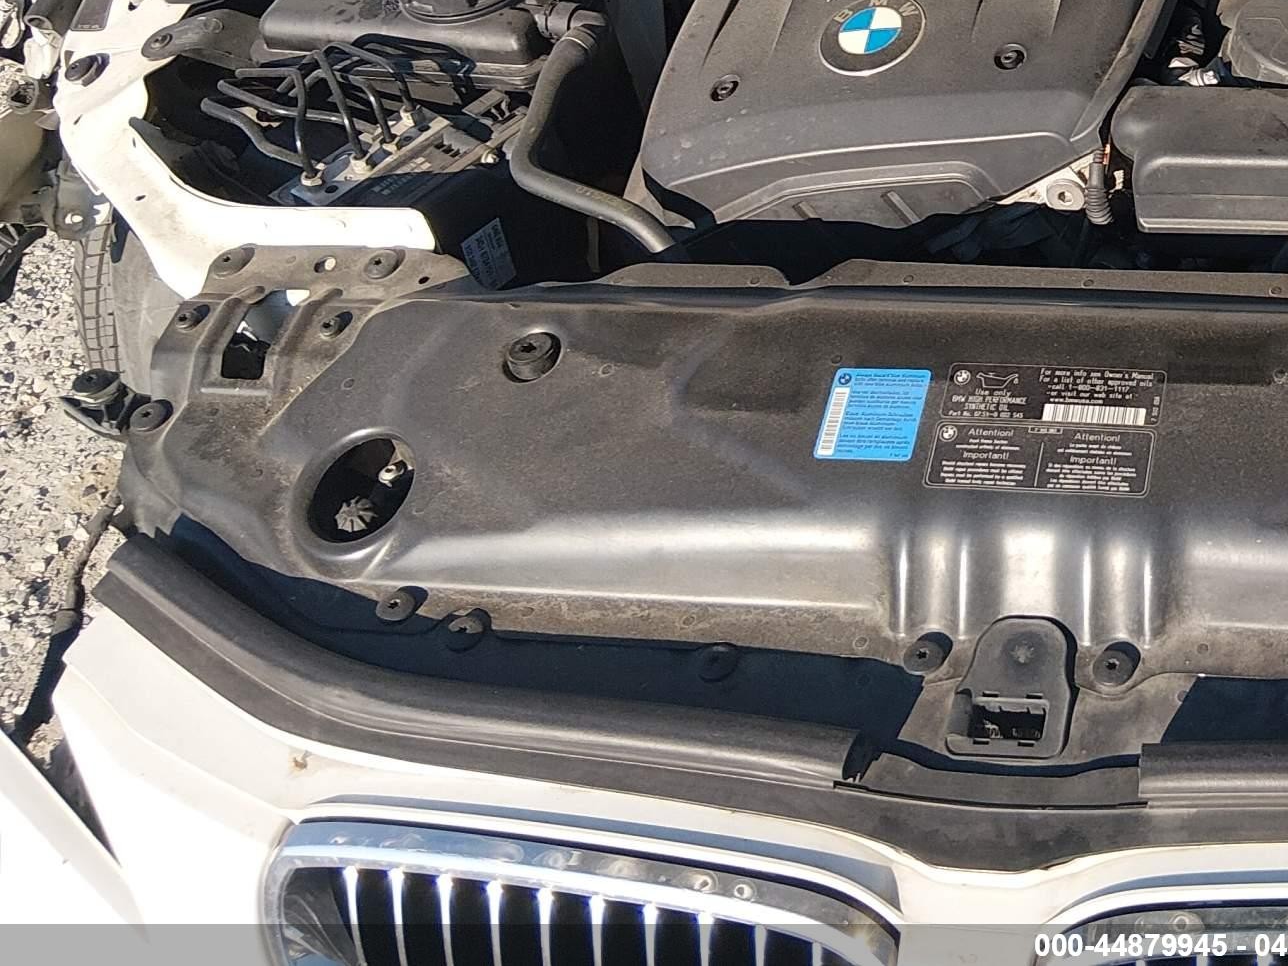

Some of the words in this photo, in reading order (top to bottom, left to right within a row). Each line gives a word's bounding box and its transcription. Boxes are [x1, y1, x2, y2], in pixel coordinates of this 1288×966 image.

[1040, 368, 1052, 376] For
[1073, 369, 1087, 377] info
[1104, 370, 1129, 379] Owner's
[1131, 371, 1154, 380] Manual
[1039, 375, 1051, 383] For
[1061, 376, 1073, 384] list
[1107, 379, 1137, 387] approved
[975, 388, 990, 396] Use
[993, 389, 1012, 398] only
[952, 395, 966, 403] BMW
[985, 396, 1028, 405] PERFORMANCE
[1049, 396, 1104, 404] www.bmwusa.com
[963, 402, 997, 411] SYNTHETIC
[998, 403, 1009, 412] OIL
[968, 428, 1014, 438] Attention!
[1074, 432, 1121, 443] Attention!
[962, 451, 1010, 461] Important!
[1069, 455, 1117, 466] Important!
